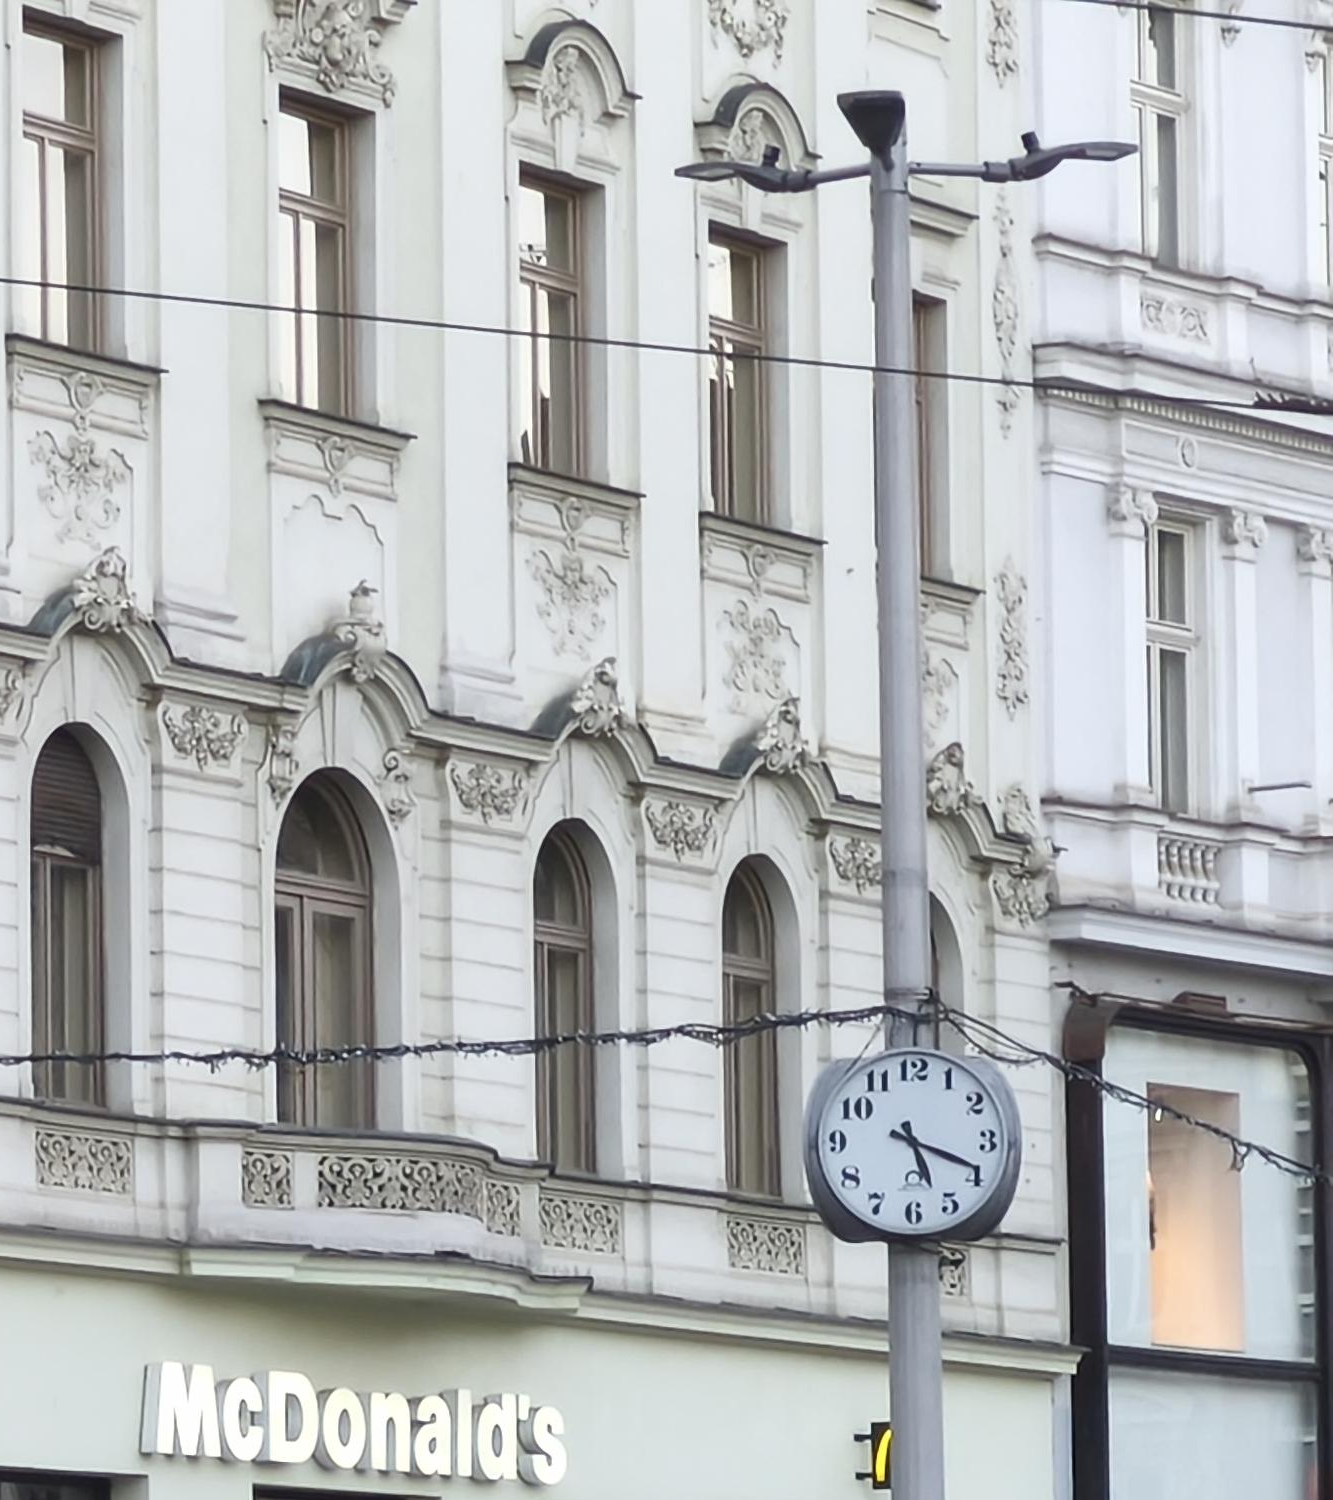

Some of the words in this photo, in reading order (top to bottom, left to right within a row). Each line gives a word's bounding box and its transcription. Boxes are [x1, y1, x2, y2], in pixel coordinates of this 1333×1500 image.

[865, 1069, 889, 1092] 11
[900, 1058, 928, 1081] 12
[944, 1067, 955, 1090] 1
[841, 1096, 873, 1120] 10
[966, 1092, 983, 1115] 2
[829, 1129, 847, 1153] 9
[979, 1129, 997, 1152] 3
[841, 1165, 860, 1189] 8
[965, 1165, 984, 1187] 4
[868, 1192, 885, 1215] 7
[905, 1201, 923, 1225] 6
[942, 1192, 959, 1215] 5
[141, 1361, 568, 1486] McDonald's
